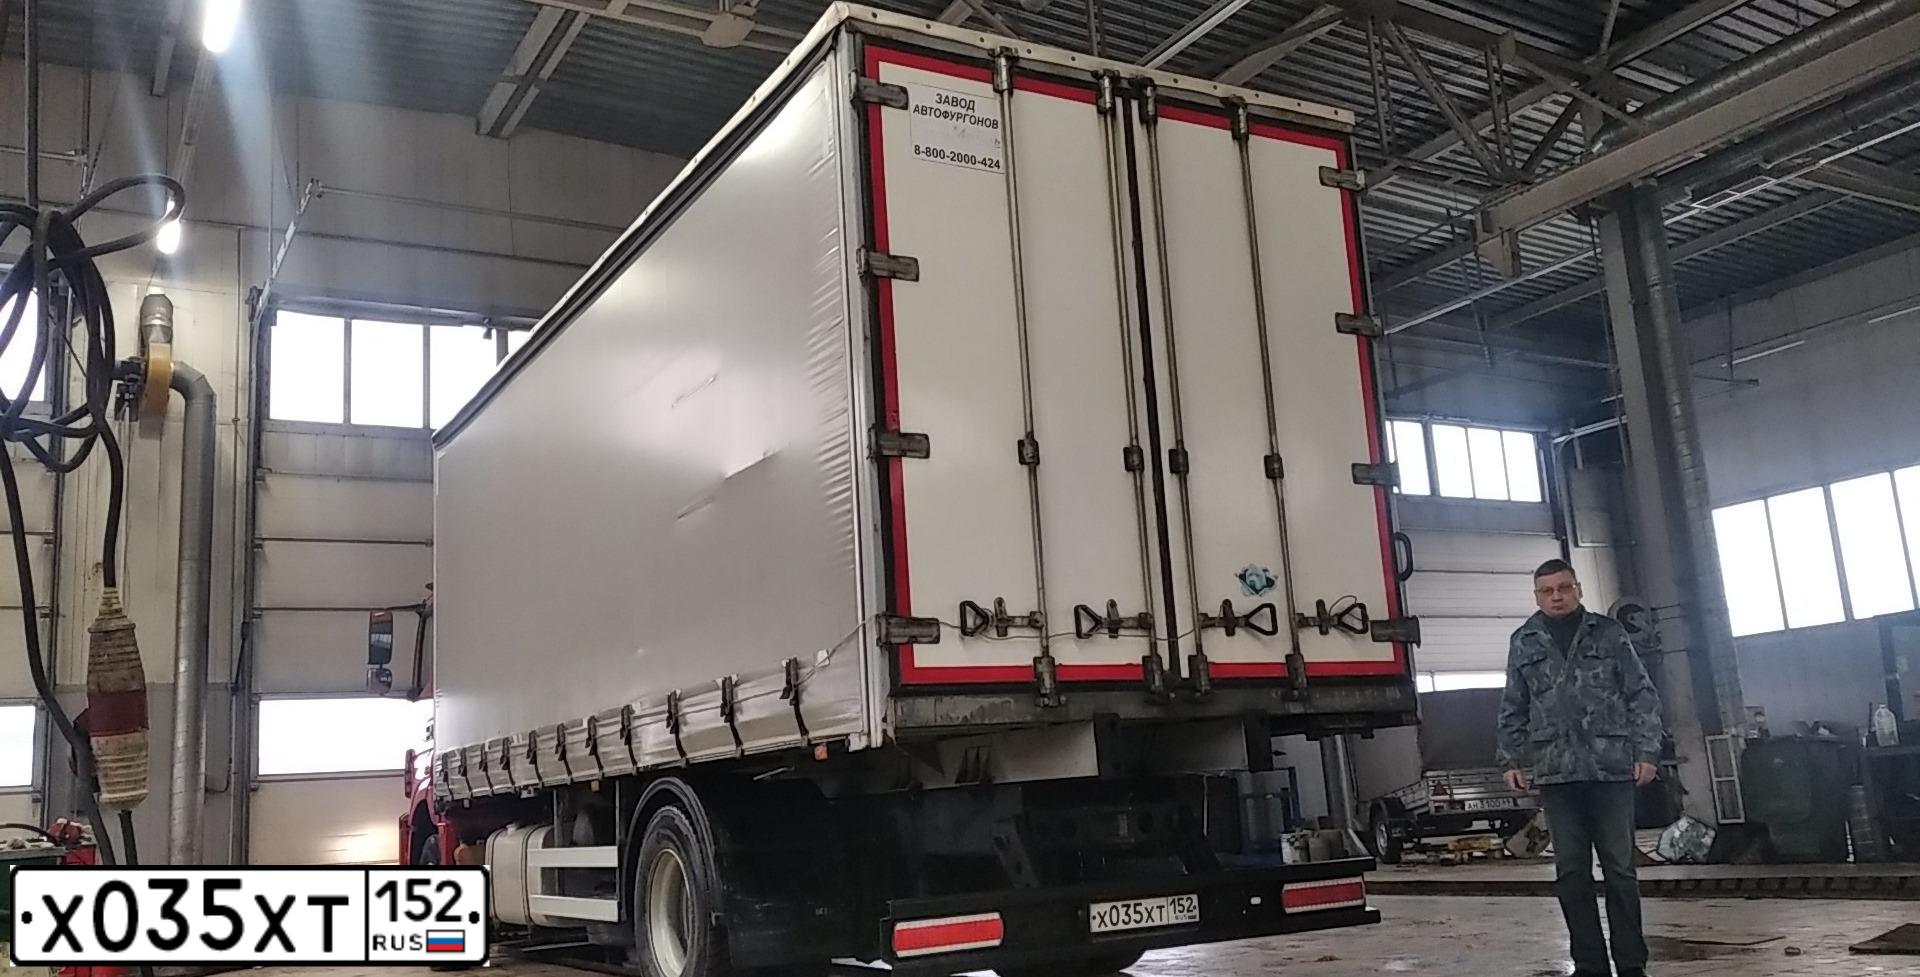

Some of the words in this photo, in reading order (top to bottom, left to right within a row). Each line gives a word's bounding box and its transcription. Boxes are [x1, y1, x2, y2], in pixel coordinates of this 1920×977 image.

[936, 93, 975, 113] ЗАВОД
[913, 104, 999, 129] АВТОФУРГОНОВ
[914, 145, 1001, 169] 8-800-2000-424
[1169, 896, 1193, 914] 152
